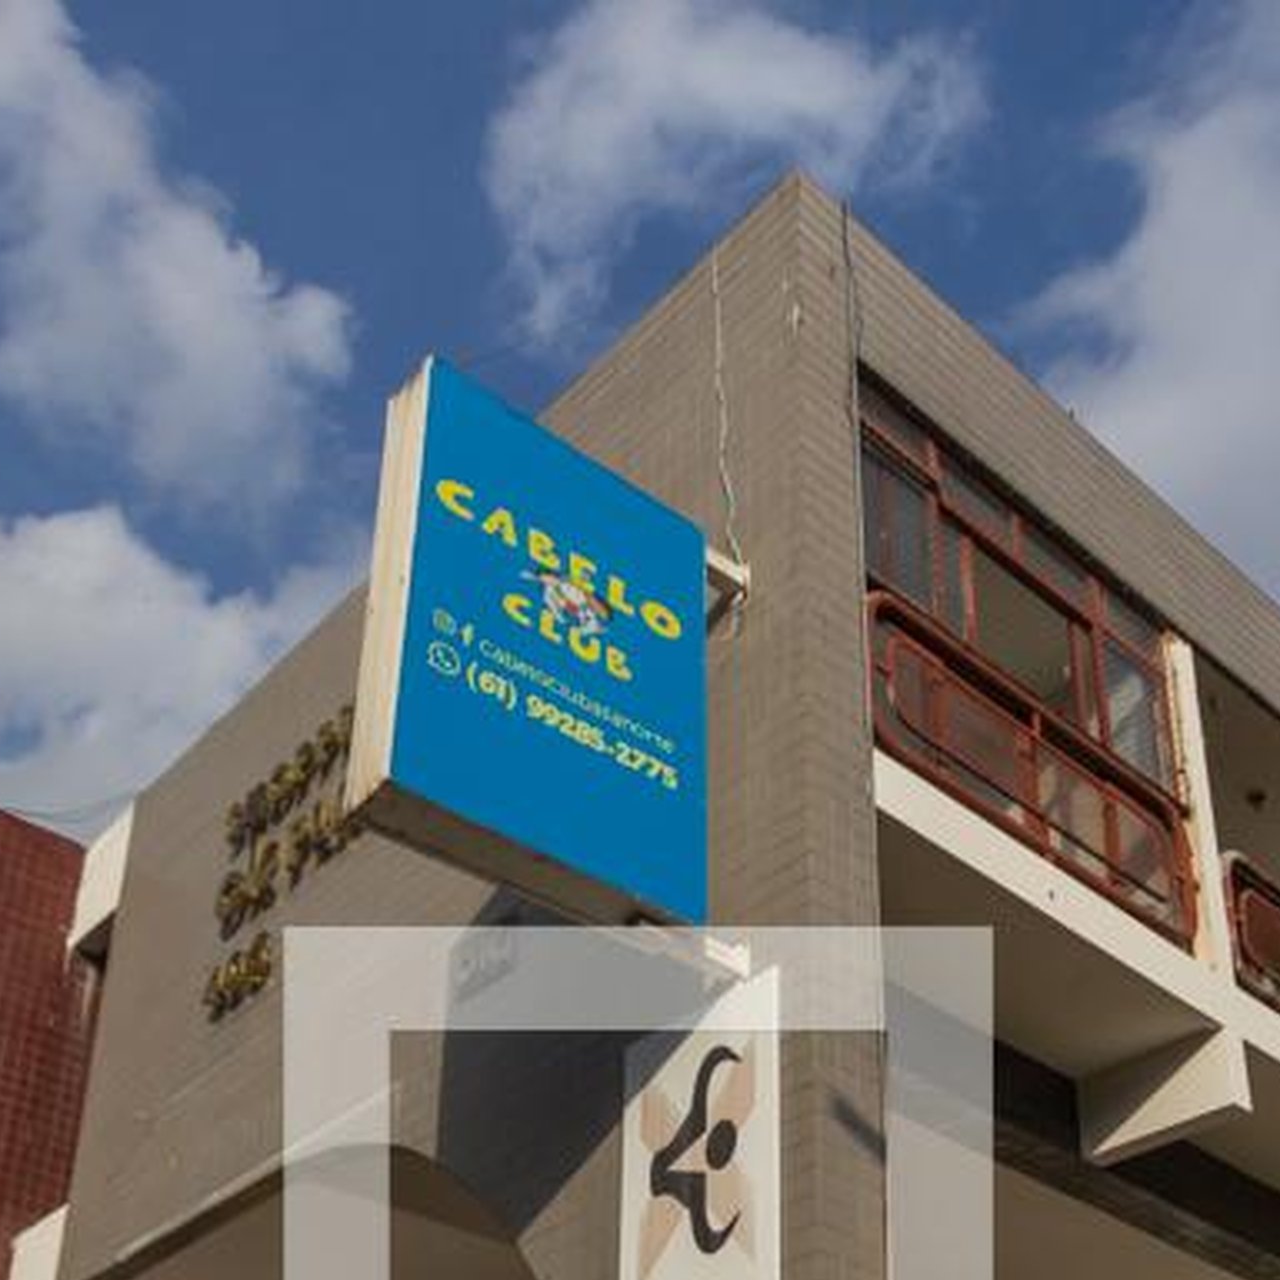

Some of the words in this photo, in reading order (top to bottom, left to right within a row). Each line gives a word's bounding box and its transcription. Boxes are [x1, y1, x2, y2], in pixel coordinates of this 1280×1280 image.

[435, 478, 683, 640] CABELO
[501, 592, 633, 682] CLUB
[466, 661, 518, 712] (61)
